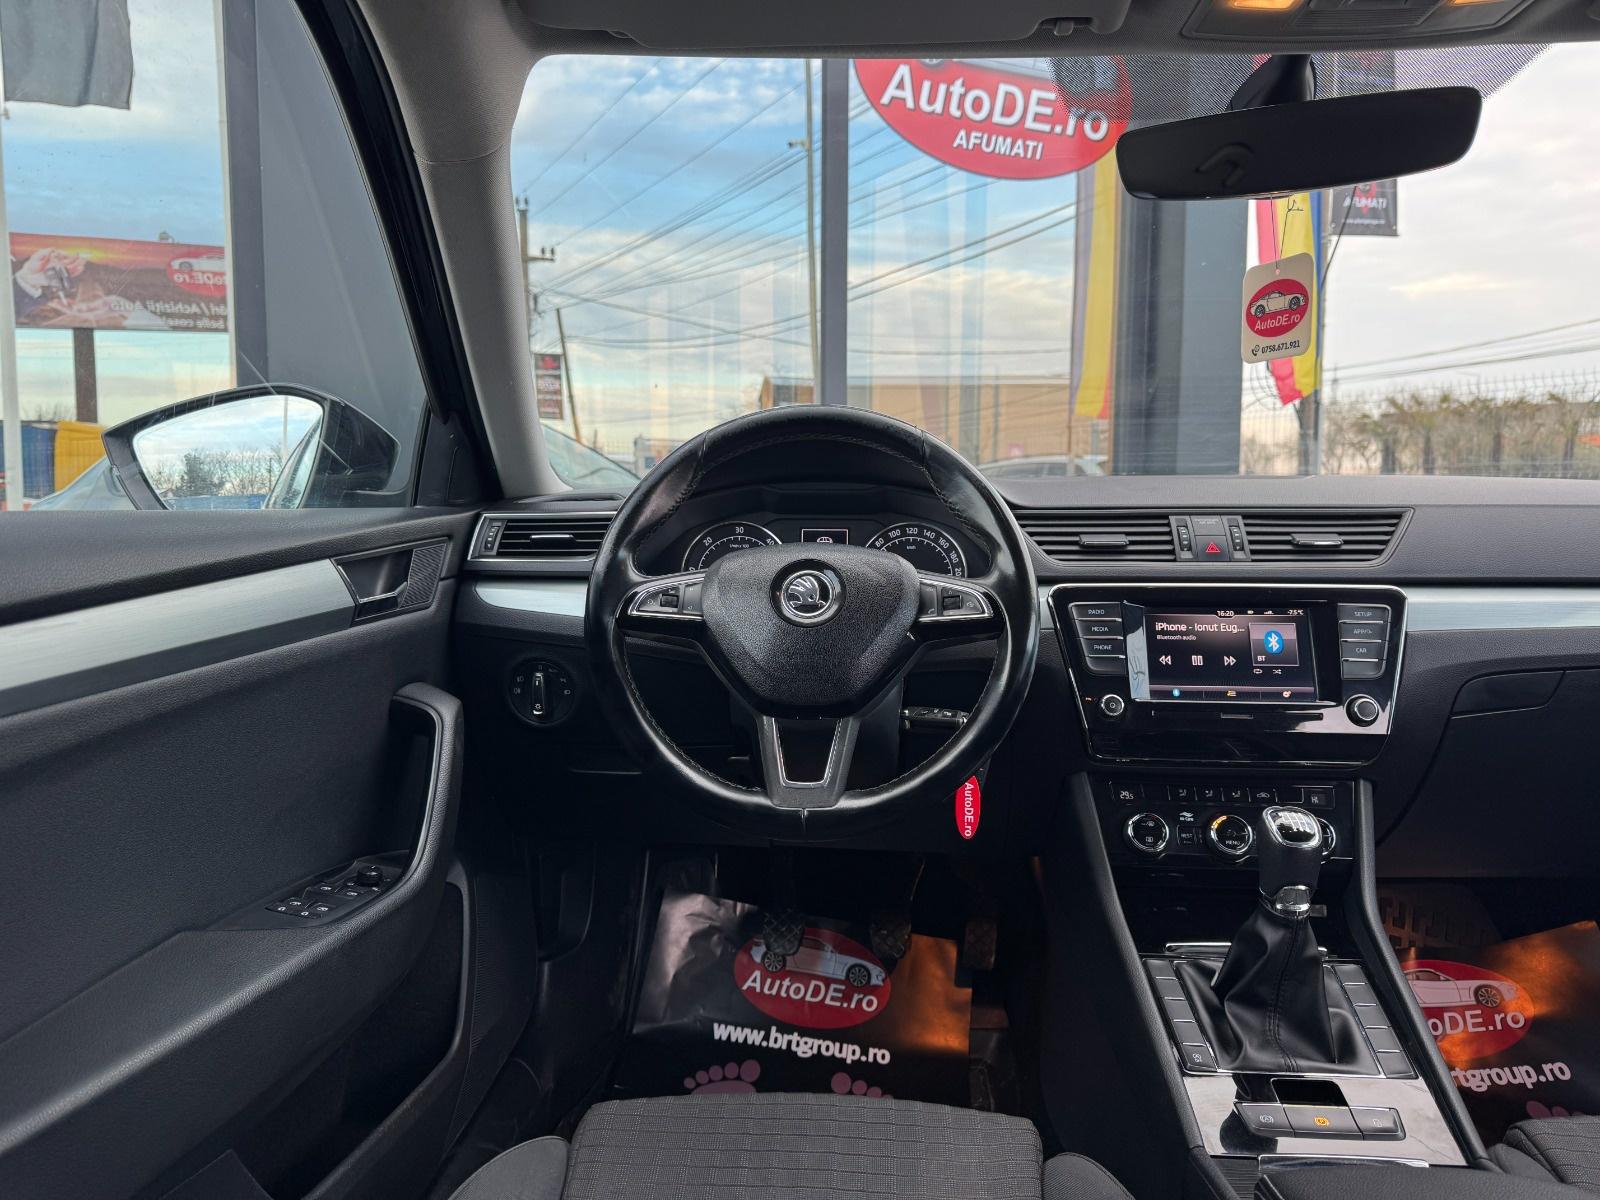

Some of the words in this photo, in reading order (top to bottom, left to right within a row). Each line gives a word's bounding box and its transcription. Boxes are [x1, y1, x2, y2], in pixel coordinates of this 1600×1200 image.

[880, 64, 1110, 141] AutoDE.ro
[953, 129, 1043, 160] AFUMATI
[1254, 313, 1301, 331] AutoDE.ro
[735, 526, 744, 534] 30
[888, 529, 901, 539] 100
[923, 529, 936, 539] 140
[703, 536, 713, 546] 20
[875, 537, 885, 548] 80
[939, 536, 950, 549] 160
[949, 550, 959, 564] 180
[1155, 622, 1187, 632] iPhone
[963, 782, 975, 837] AutoDE.ro
[742, 970, 878, 1012] AutoDE.ro
[1427, 1009, 1526, 1037] oDE.ro
[713, 1022, 891, 1064] www.brtgroup.ro
